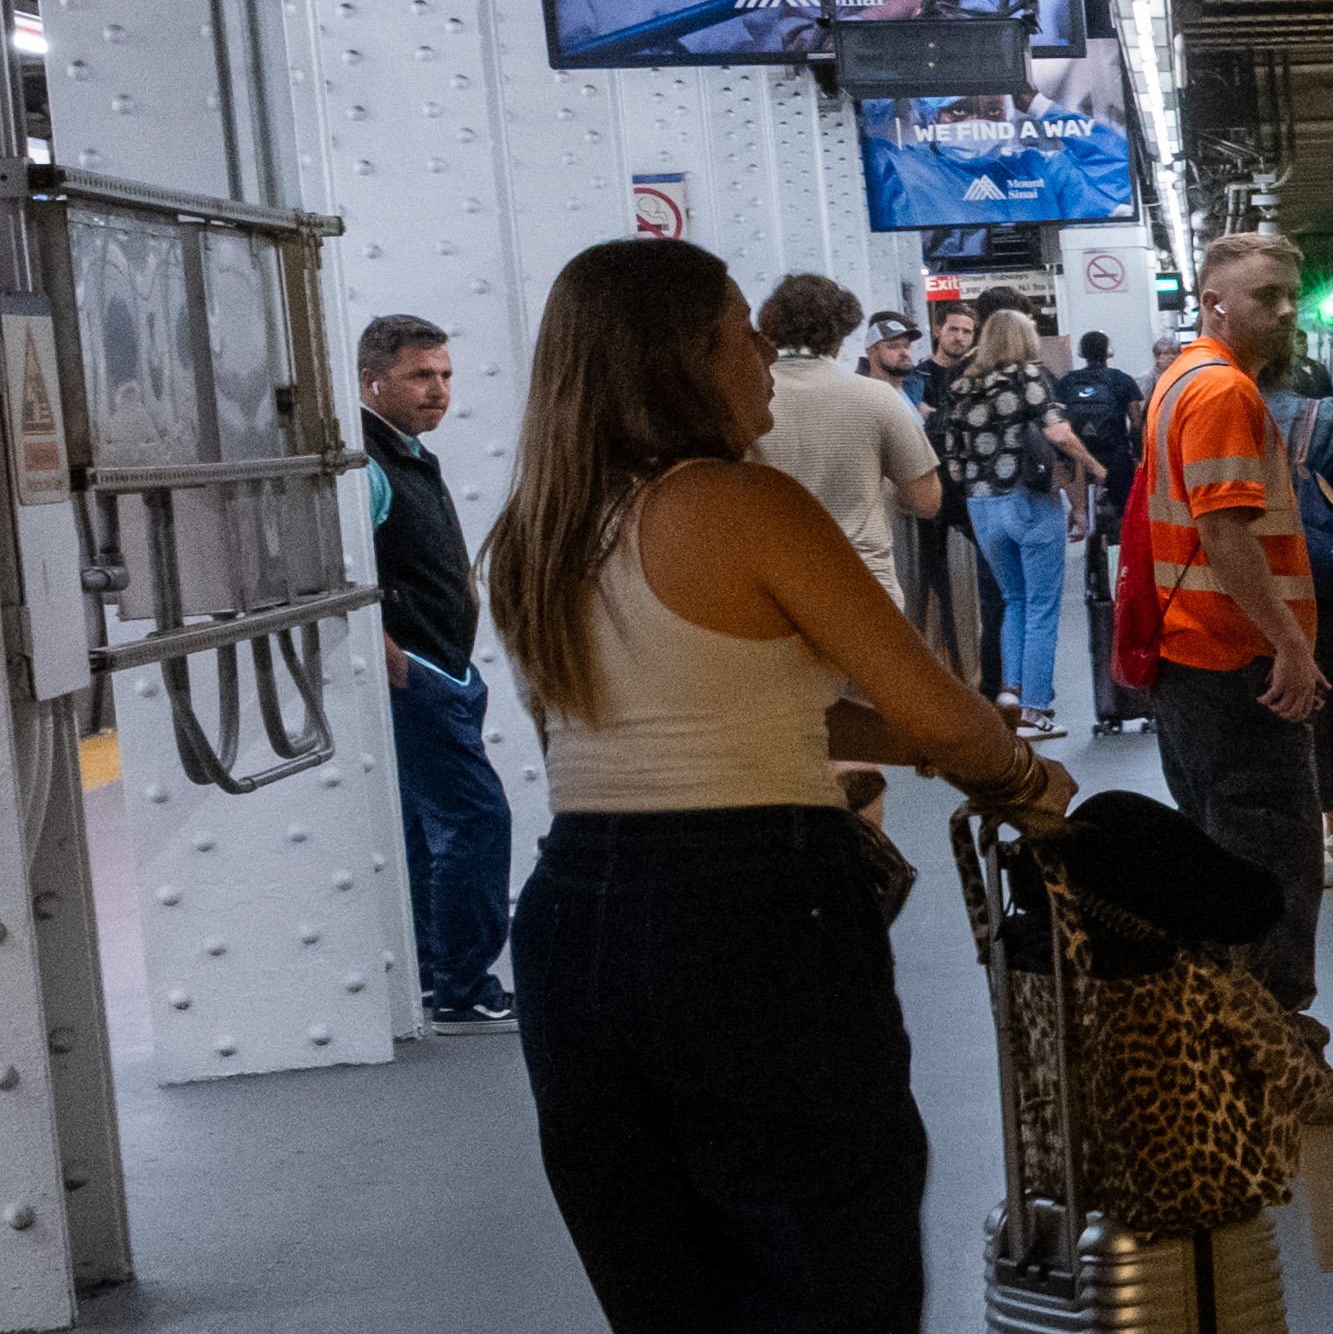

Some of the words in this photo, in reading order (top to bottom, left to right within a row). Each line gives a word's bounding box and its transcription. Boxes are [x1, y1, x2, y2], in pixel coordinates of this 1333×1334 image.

[914, 124, 951, 142] WE
[956, 122, 1015, 140] FIND
[1020, 121, 1038, 138] A
[1044, 119, 1095, 137] WAY
[1007, 178, 1045, 188] Mount
[1008, 189, 1038, 199] Sinai
[926, 276, 960, 291] Exit
